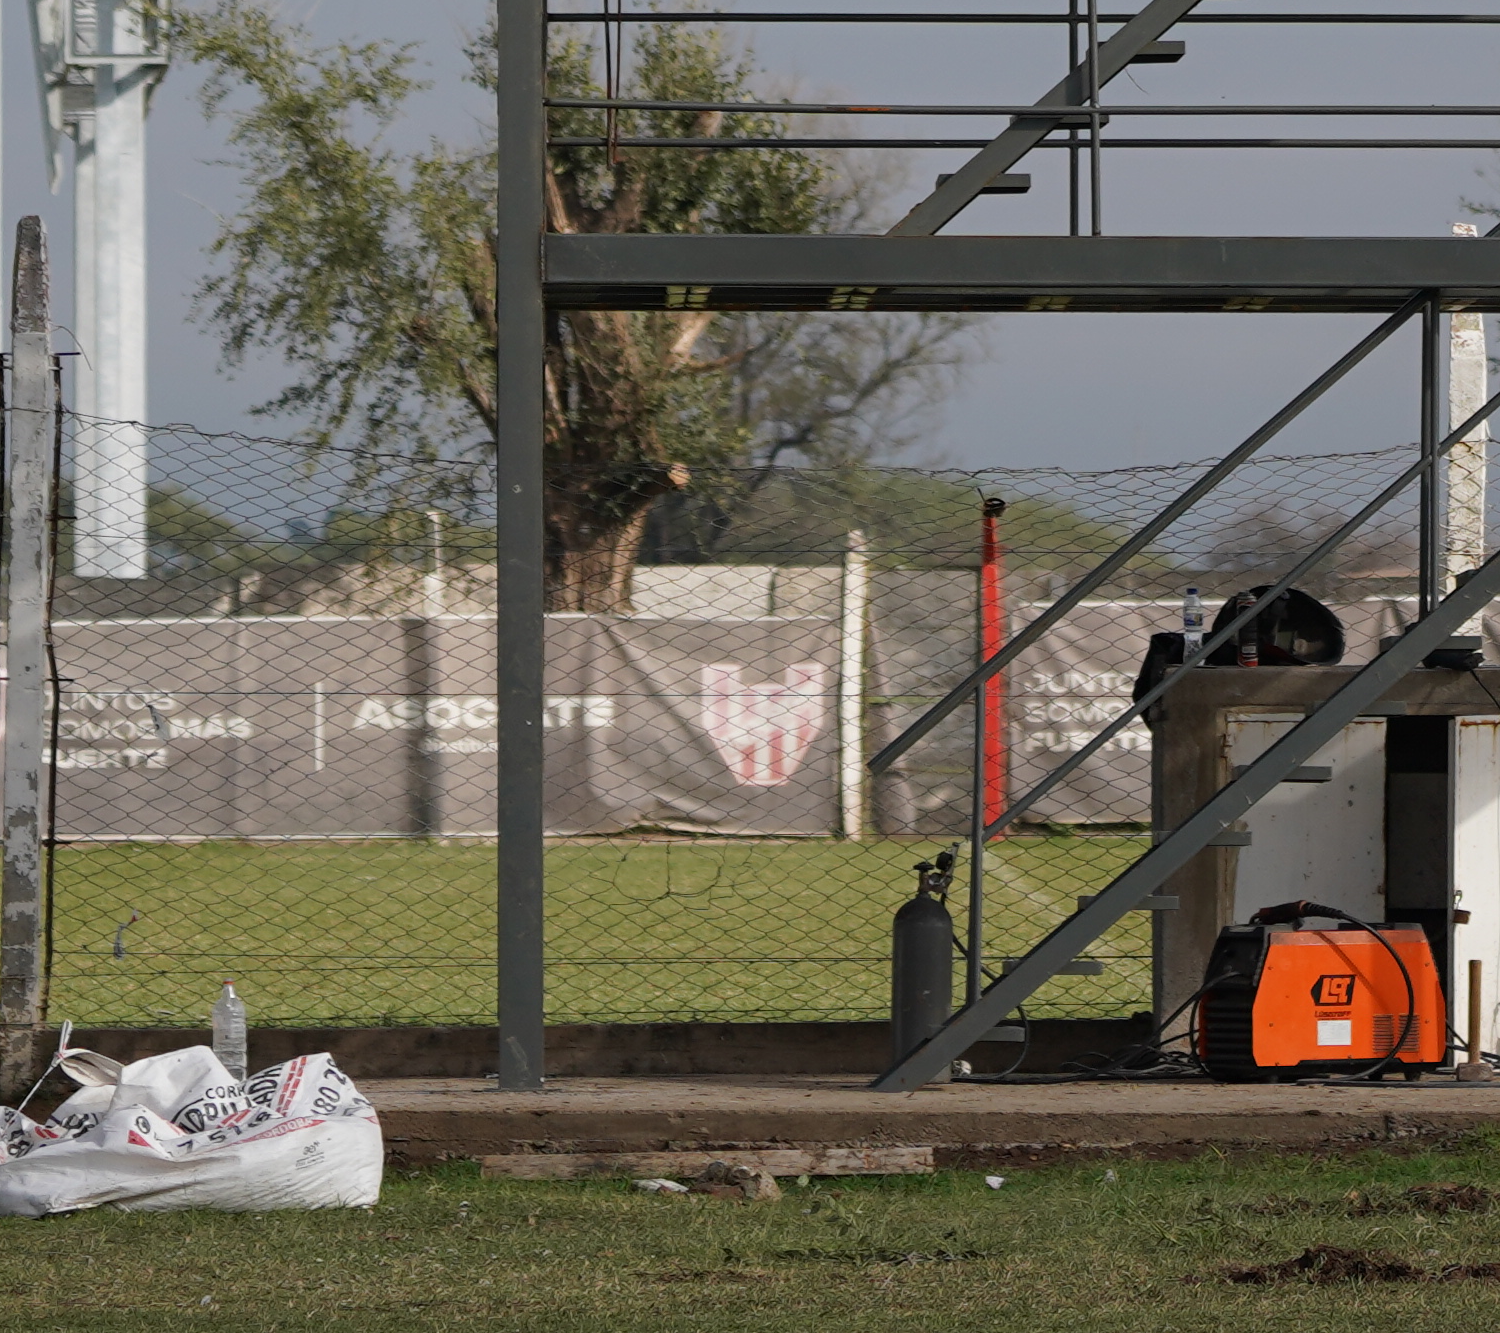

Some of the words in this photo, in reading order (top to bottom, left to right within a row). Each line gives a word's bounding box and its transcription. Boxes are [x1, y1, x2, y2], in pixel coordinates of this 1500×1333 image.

[1023, 673, 1138, 693] JUNTO
[351, 696, 616, 730] ASOCTE
[1023, 702, 1143, 723] SOMO
